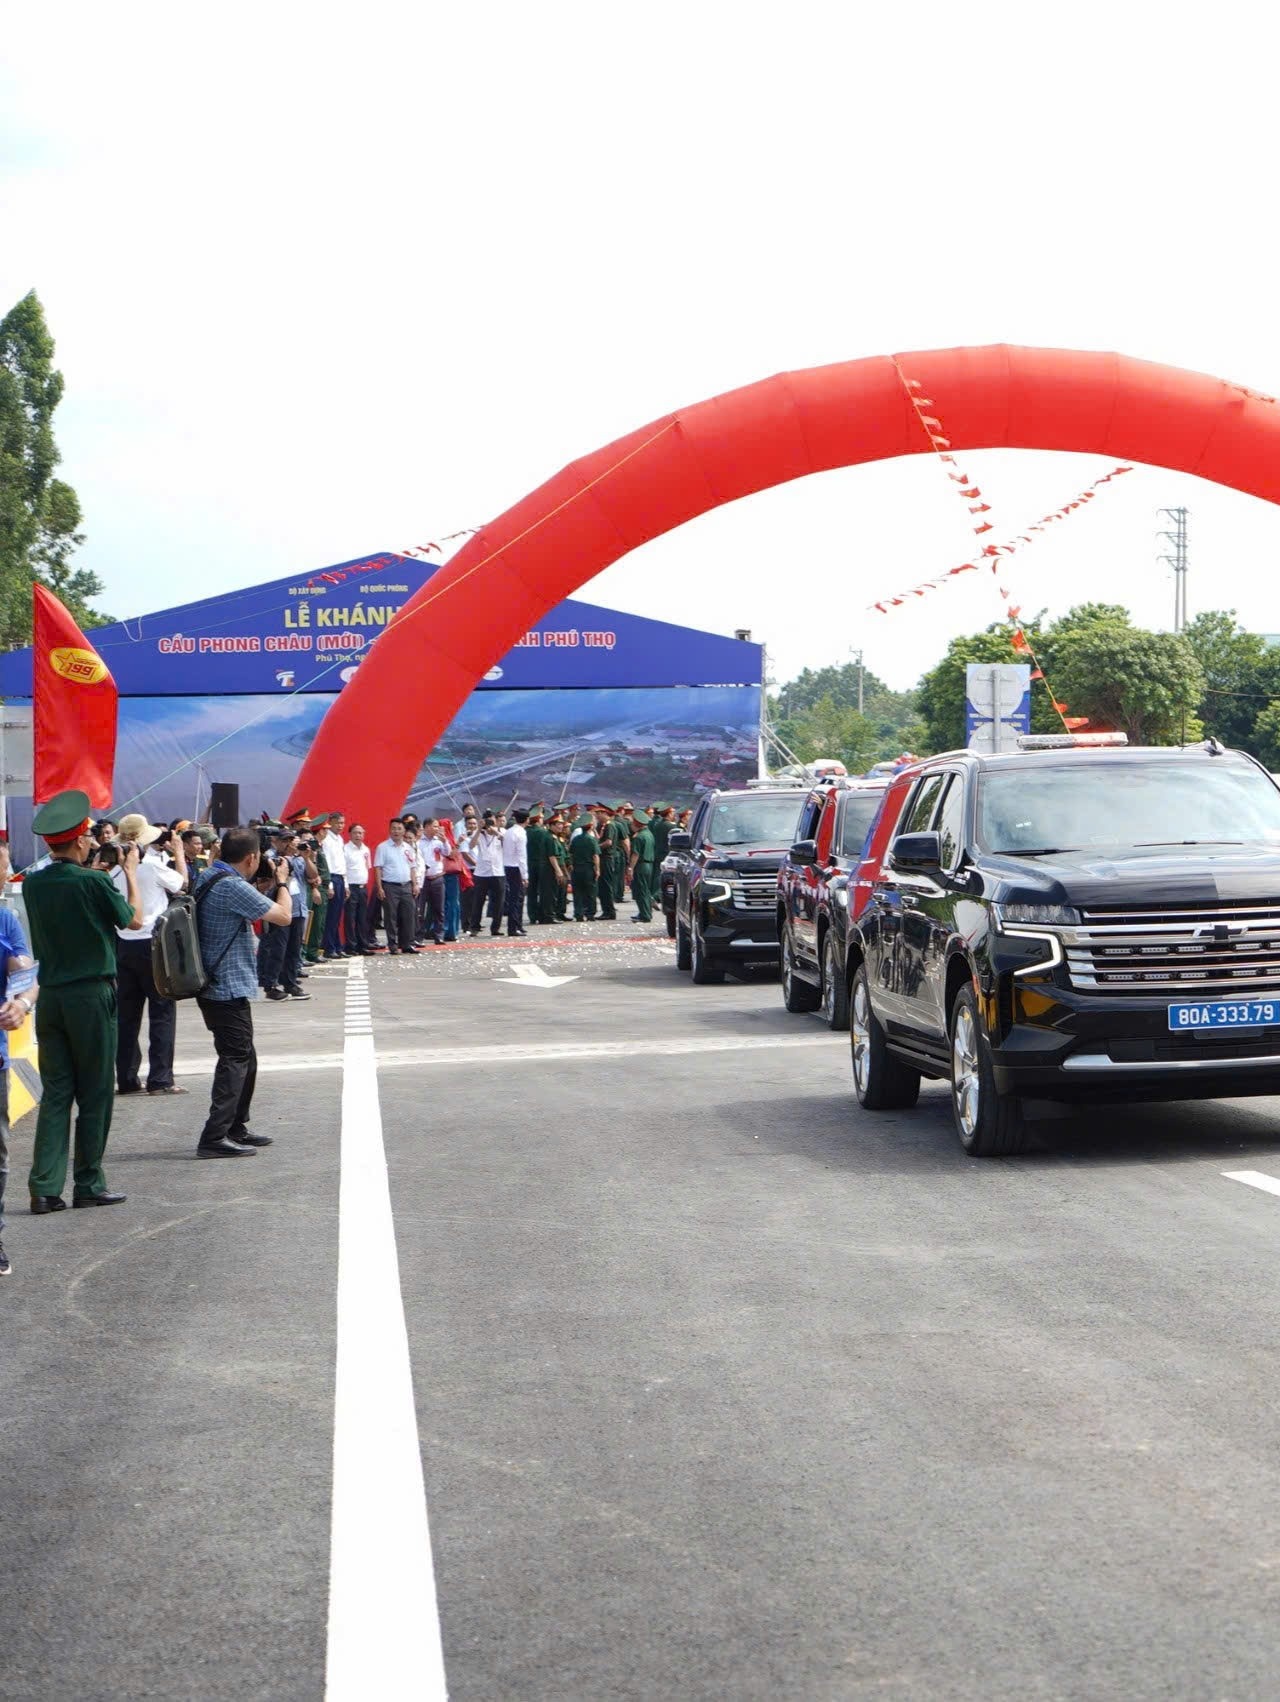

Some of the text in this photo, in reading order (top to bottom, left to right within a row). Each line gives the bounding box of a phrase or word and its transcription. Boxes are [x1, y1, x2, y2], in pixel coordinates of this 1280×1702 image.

[284, 601, 311, 628] LỄ
[159, 633, 195, 654] CẦU
[199, 637, 261, 653] PHONG
[264, 633, 312, 652] CHÂU
[513, 629, 616, 650] NH PHÚ THỌ
[1178, 1004, 1274, 1025] 80A-333.79
